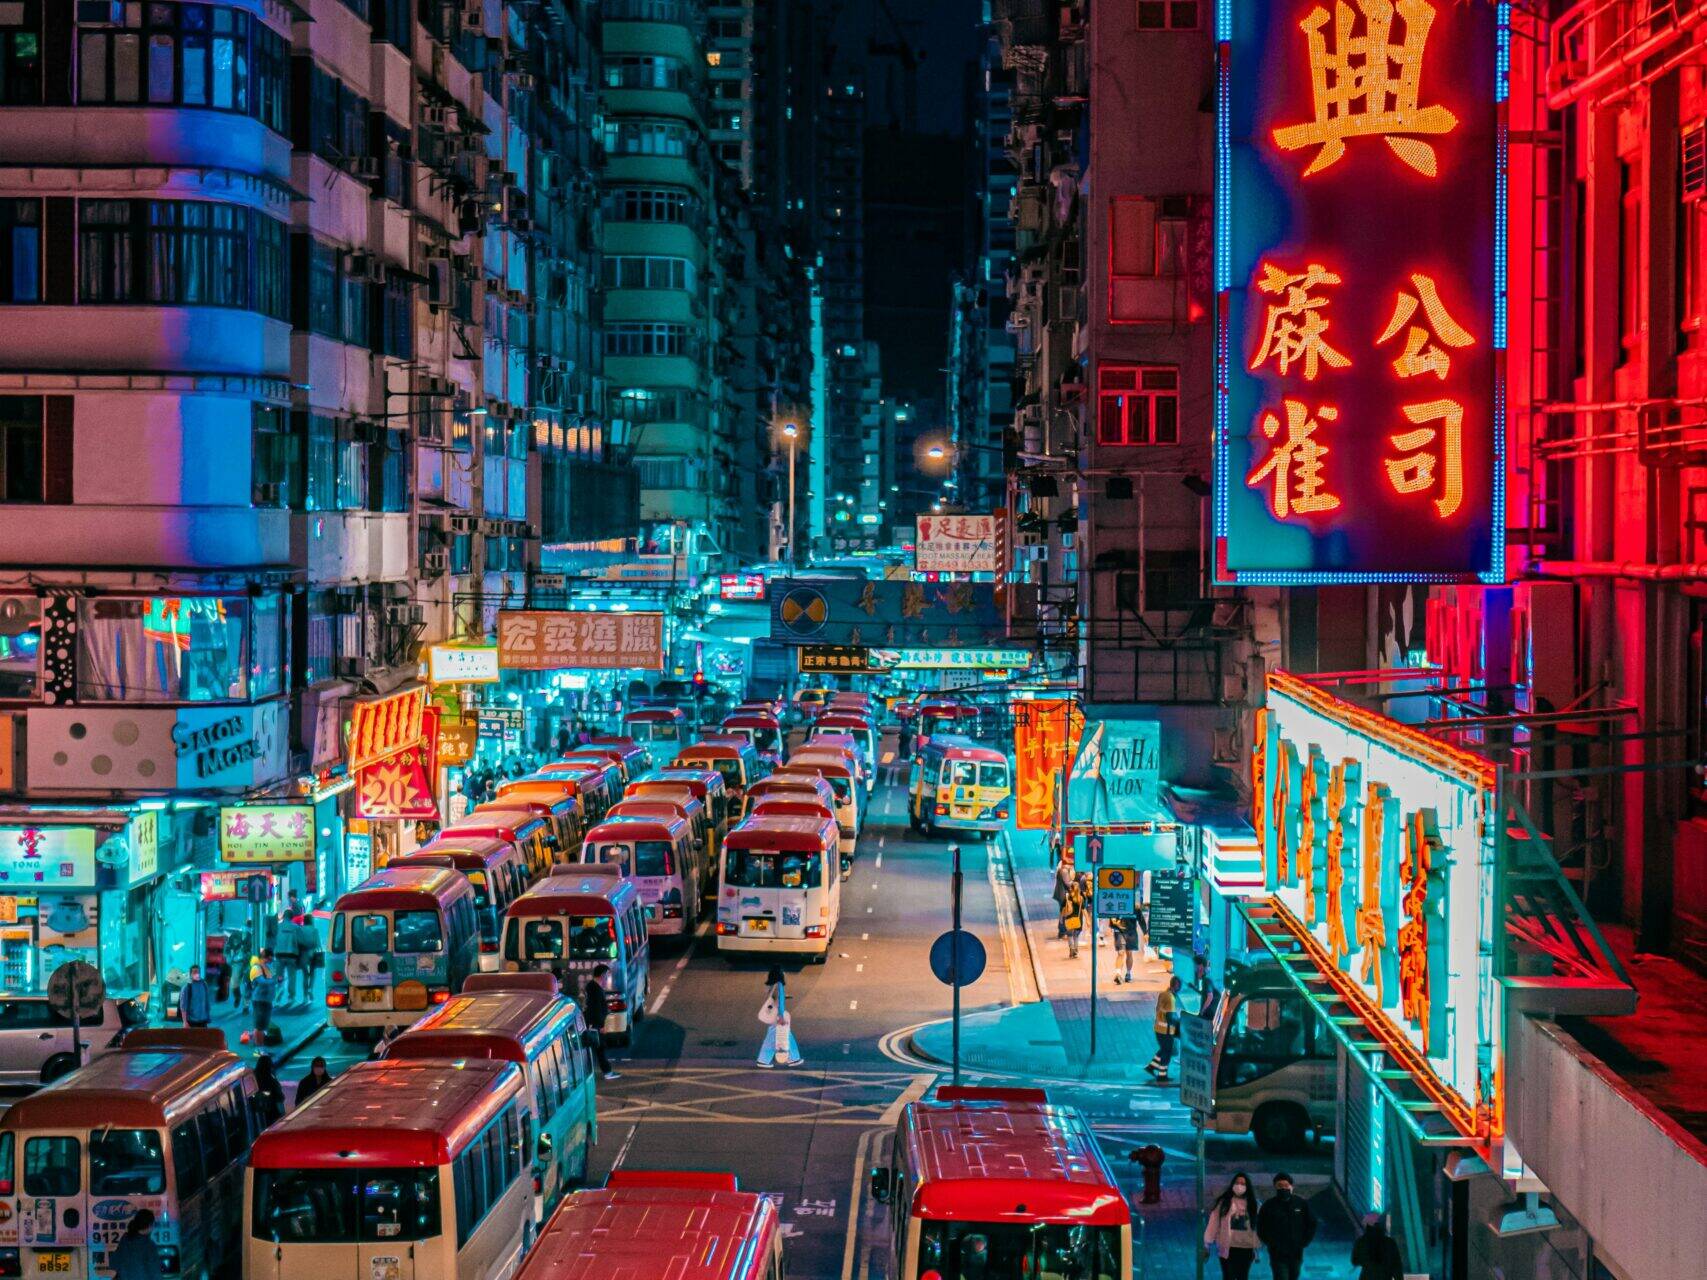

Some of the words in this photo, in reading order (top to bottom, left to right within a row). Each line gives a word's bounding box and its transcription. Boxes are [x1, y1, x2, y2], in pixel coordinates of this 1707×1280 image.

[1273, 0, 1460, 178] 興
[1375, 272, 1477, 519] 公司
[370, 778, 406, 806] 20
[226, 811, 313, 840] 海天堂
[13, 861, 40, 869] TONG
[1102, 892, 1114, 900] 24
[1105, 901, 1126, 911] 全日
